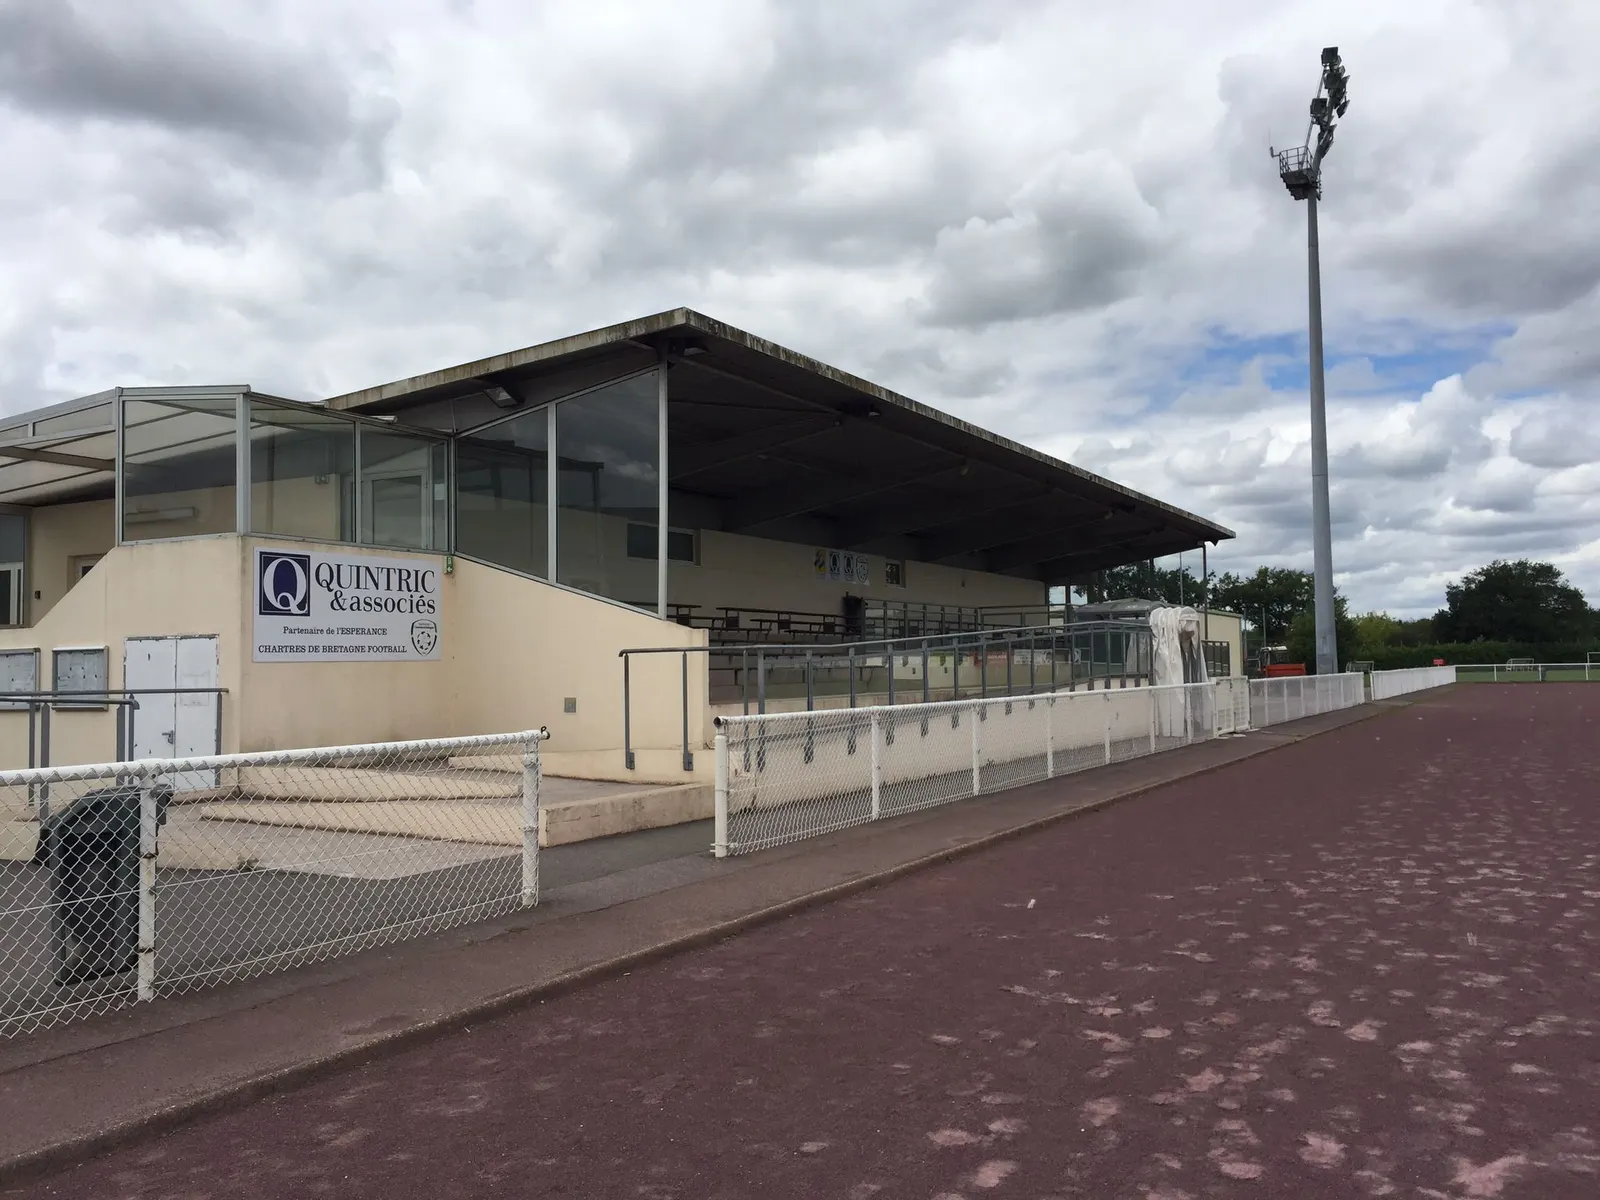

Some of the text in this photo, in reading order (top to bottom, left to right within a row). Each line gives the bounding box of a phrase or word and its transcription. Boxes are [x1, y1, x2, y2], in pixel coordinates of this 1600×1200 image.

[315, 562, 436, 594] QUINTRIC
[282, 626, 388, 636] Partenaire de l'ESPERANCE
[258, 645, 407, 654] CHARTRES DE BRETAGNE FOOTBALL
